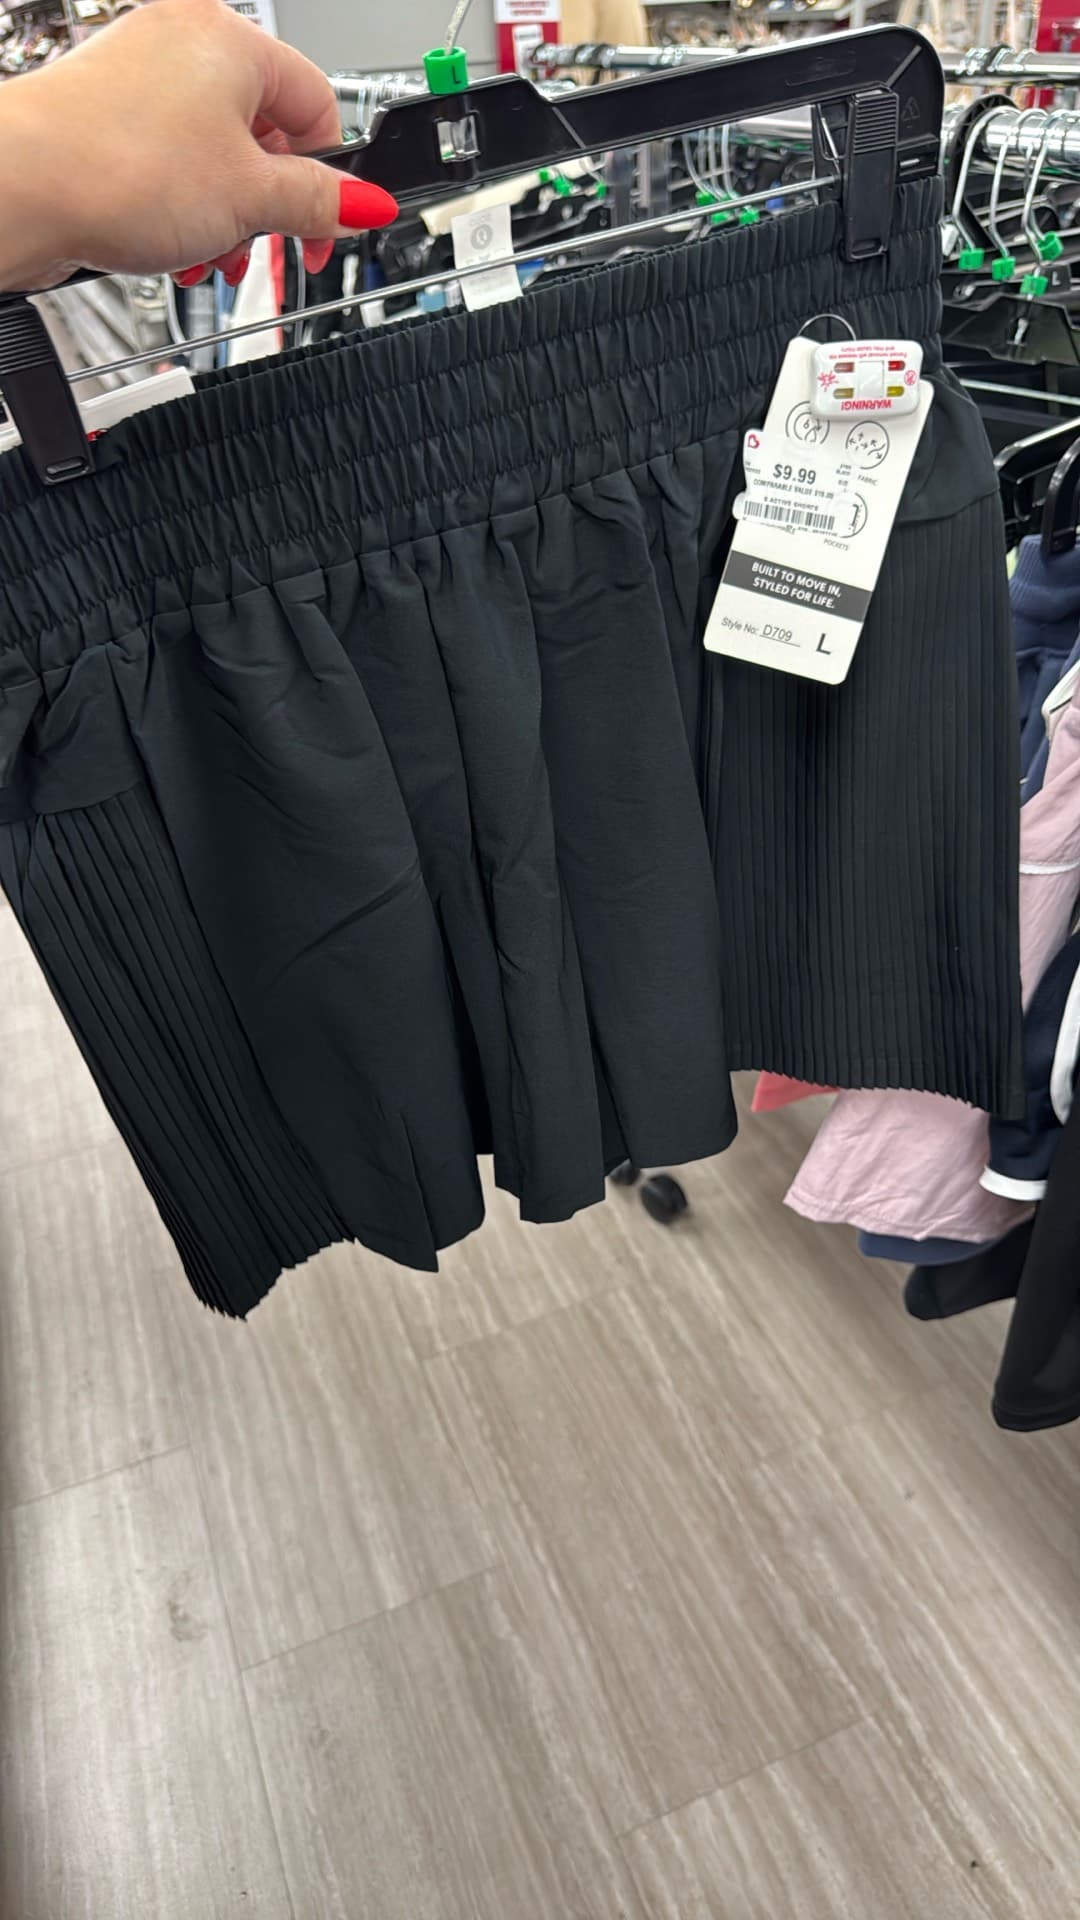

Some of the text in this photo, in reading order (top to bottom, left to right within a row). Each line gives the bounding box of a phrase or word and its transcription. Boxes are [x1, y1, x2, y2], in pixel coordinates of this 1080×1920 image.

[451, 65, 462, 85] L
[1052, 271, 1061, 286] L
[841, 399, 891, 411] WARNING!
[773, 464, 817, 485] $9.99
[858, 474, 879, 486] FABRIC
[753, 478, 793, 492] COMPARABLE
[769, 497, 792, 507] ACTIVE
[793, 500, 819, 512] SHORTS
[823, 538, 849, 551] POCKETS
[752, 562, 842, 598] BUILT TO MOVE IN,
[753, 577, 835, 609] STYLED FOR LIFE.
[721, 617, 793, 643] Style No: D709
[816, 632, 831, 655] L
